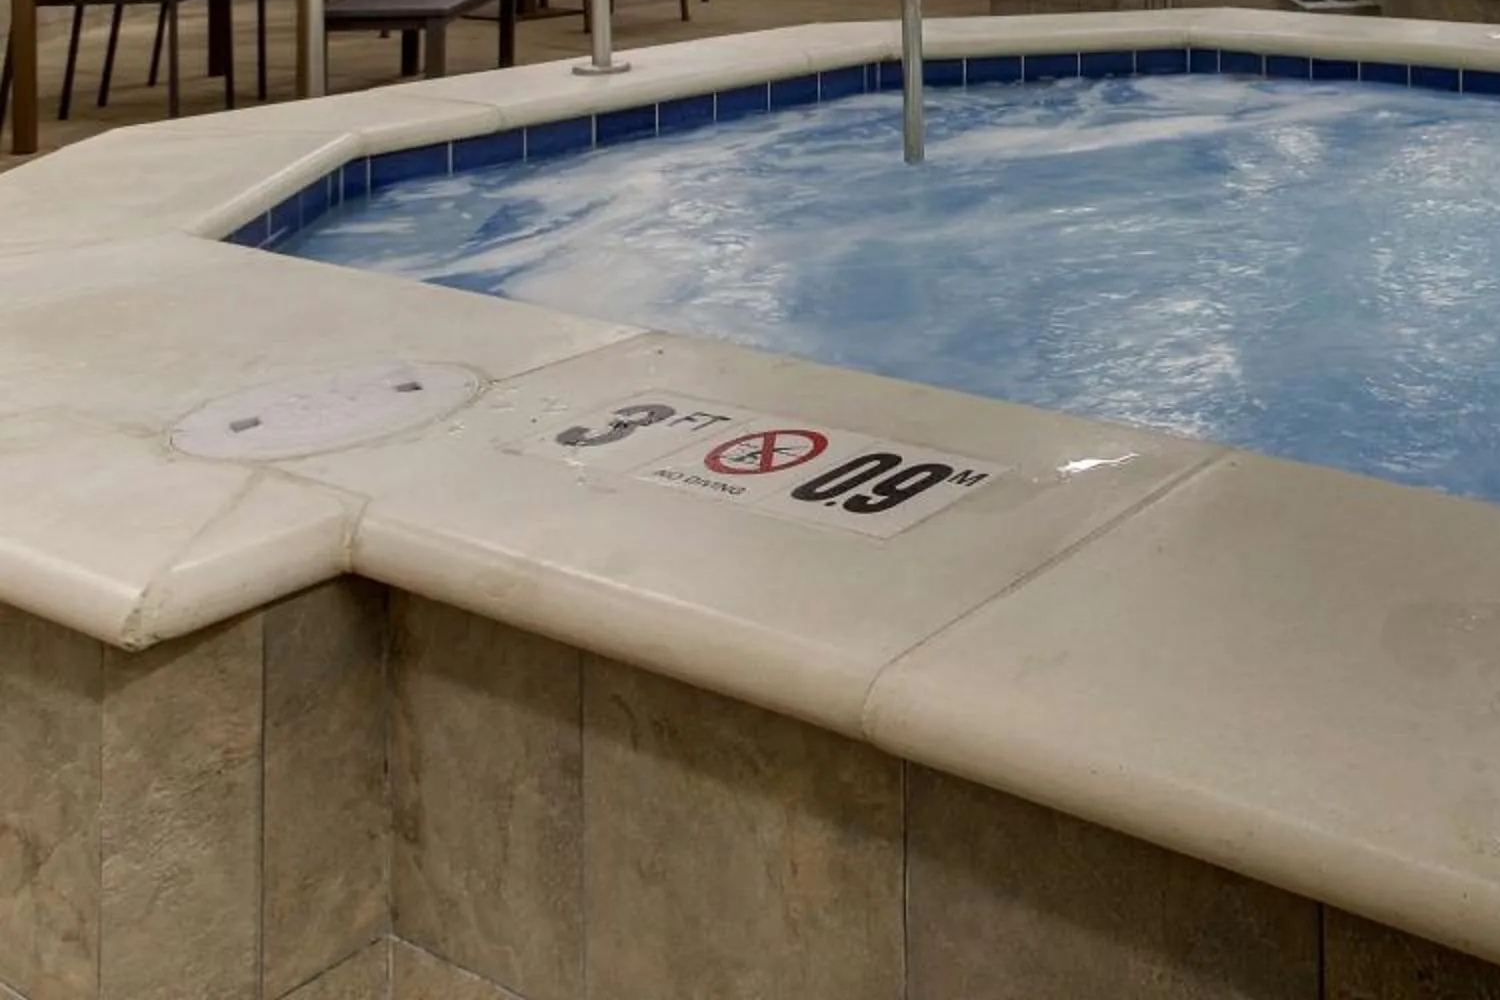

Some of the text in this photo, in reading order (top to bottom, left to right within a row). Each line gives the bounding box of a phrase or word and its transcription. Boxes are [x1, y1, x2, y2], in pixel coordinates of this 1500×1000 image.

[555, 403, 732, 447] 3 FT
[652, 469, 748, 496] NO DIVING
[791, 453, 990, 514] 0.9 M
